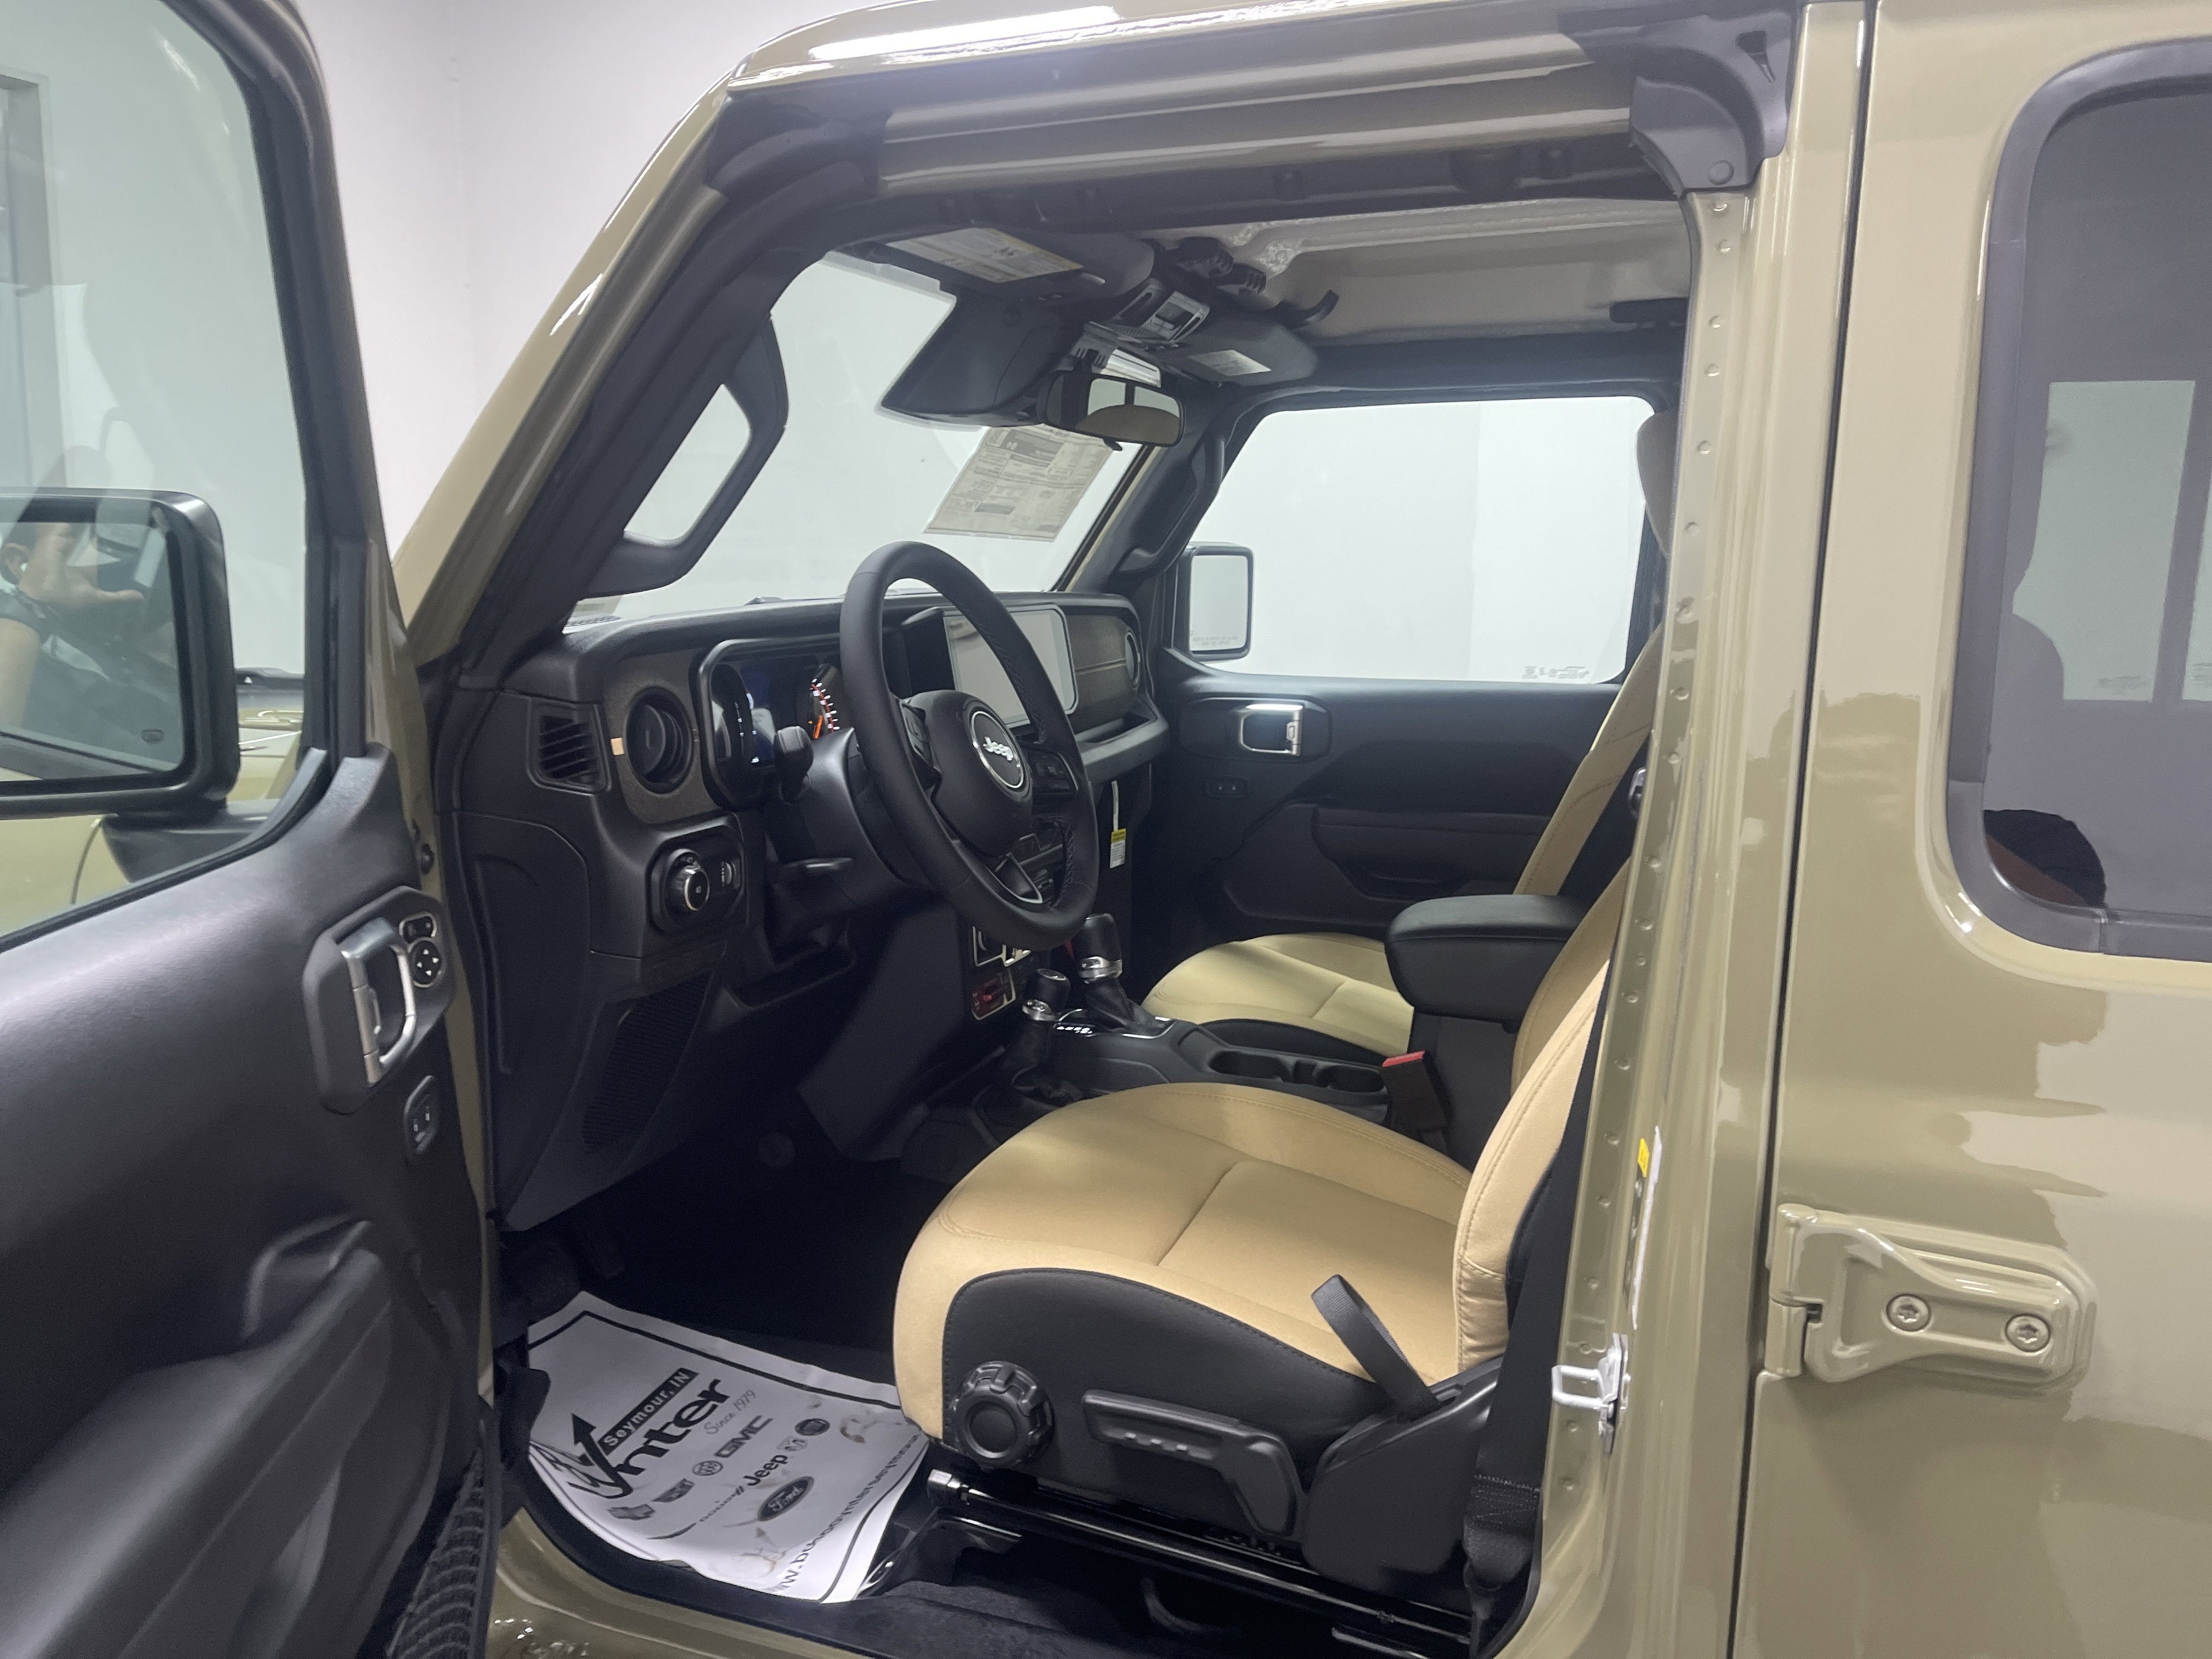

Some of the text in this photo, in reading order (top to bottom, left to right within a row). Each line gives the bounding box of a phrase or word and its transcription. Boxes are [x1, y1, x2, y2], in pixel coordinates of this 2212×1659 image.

[983, 736, 1014, 761] Jeep
[669, 1372, 691, 1388] IN
[703, 1389, 757, 1435] Since 1979
[714, 1415, 774, 1458] GMC
[742, 1455, 788, 1487] Jeep
